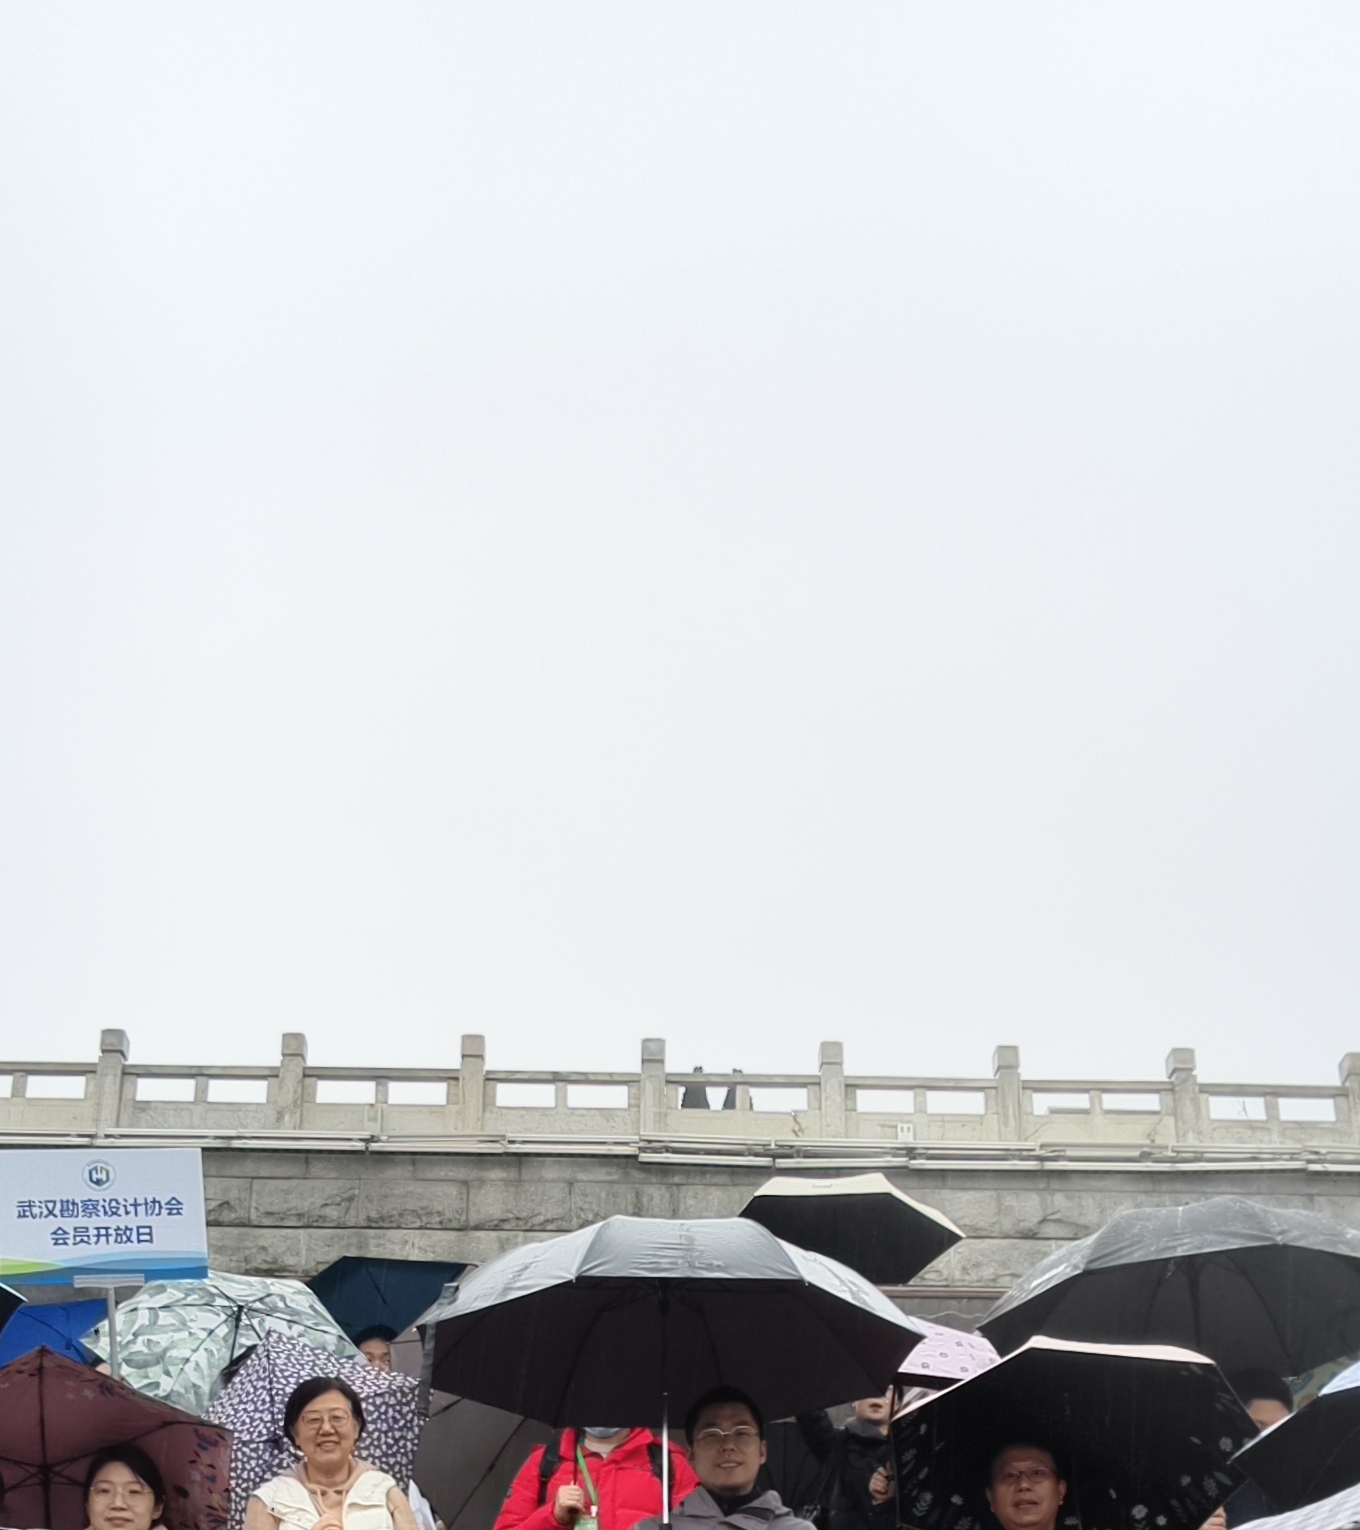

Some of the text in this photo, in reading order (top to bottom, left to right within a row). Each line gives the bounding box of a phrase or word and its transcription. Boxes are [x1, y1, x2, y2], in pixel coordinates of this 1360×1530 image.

[16, 1196, 184, 1219] 武汉勘察设计协会
[50, 1225, 154, 1246] 会员开放日
